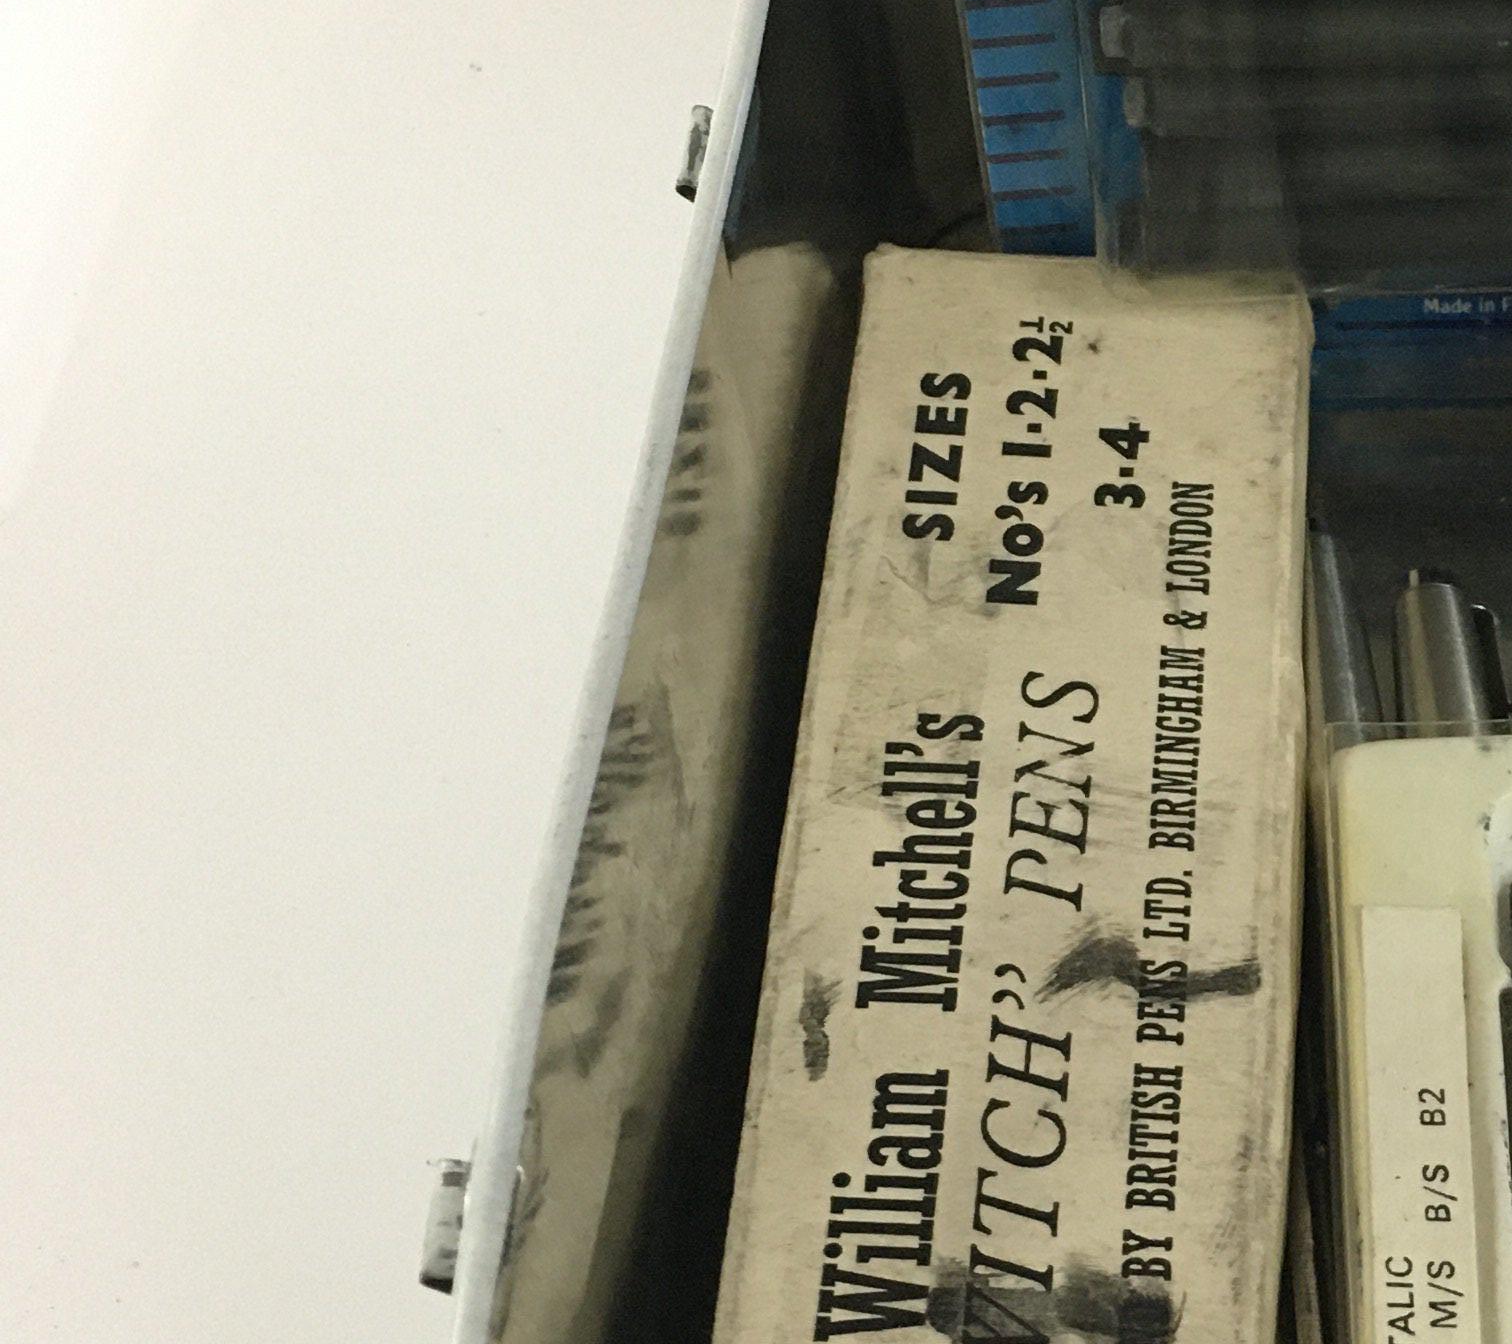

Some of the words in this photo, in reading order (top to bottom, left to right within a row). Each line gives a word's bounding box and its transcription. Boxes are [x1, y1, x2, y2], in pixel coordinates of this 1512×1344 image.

[1422, 297, 1473, 314] Made
[1479, 296, 1496, 313] in
[902, 372, 972, 541] SIZES
[1165, 480, 1215, 596] LONDON
[1163, 611, 1209, 631] &
[1003, 671, 1100, 912] PENS
[1148, 645, 1206, 852] BIRMINGHAM
[855, 712, 986, 1012] Mitchell's
[1142, 869, 1194, 942] LTD.
[1136, 958, 1190, 1046] PENS
[1125, 1063, 1184, 1211] BRITISH
[1418, 1086, 1447, 1127] B2
[813, 1068, 950, 1342] William
[1422, 1162, 1459, 1223] B/S
[1121, 1229, 1173, 1281] BY
[1426, 1260, 1465, 1329] M/S
